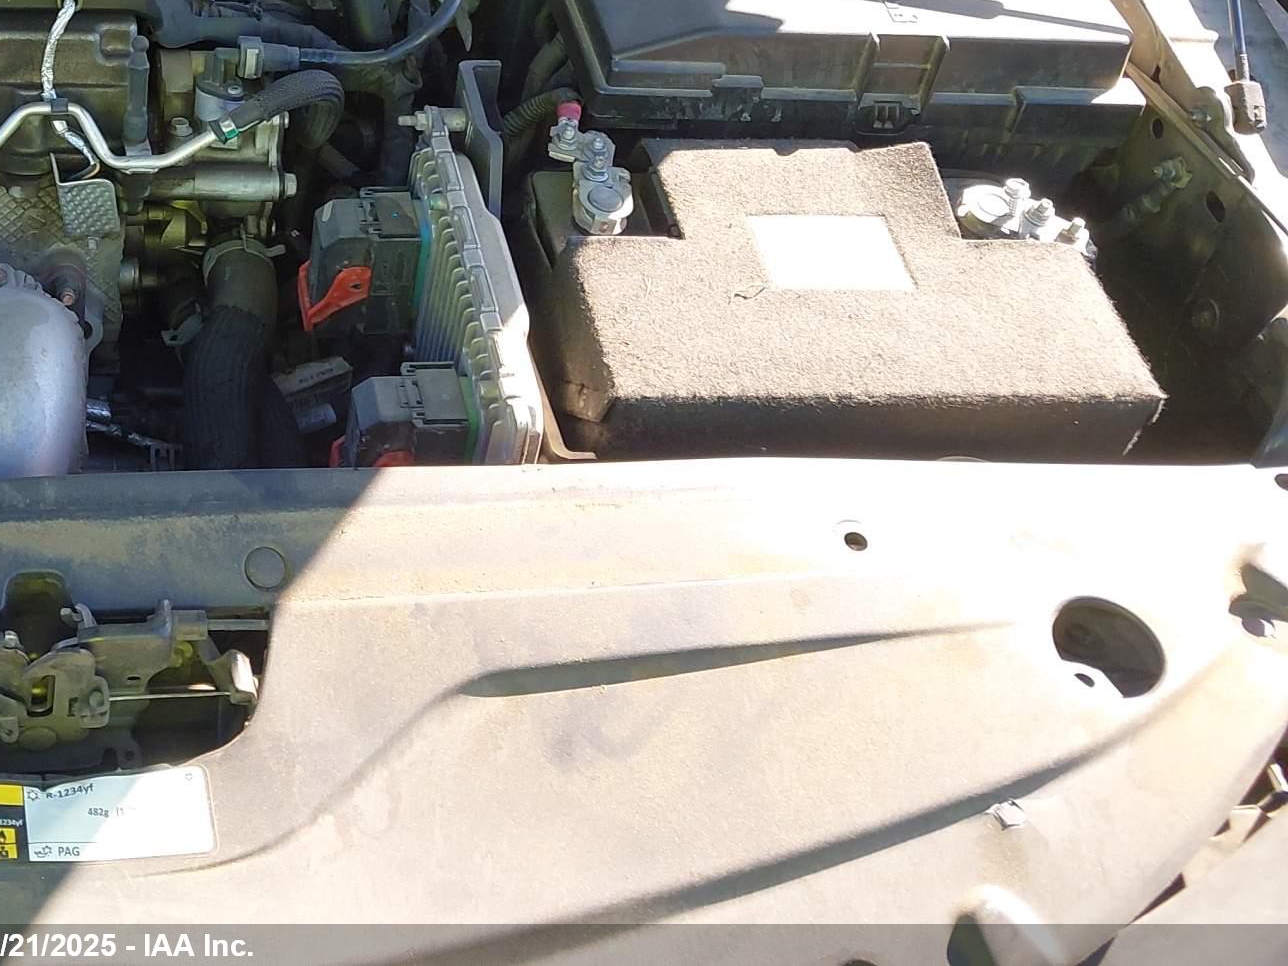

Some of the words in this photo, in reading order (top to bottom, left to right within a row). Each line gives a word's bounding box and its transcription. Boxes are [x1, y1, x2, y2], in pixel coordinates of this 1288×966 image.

[45, 782, 94, 799] R-1234yf
[87, 807, 110, 818] 482g
[57, 846, 81, 857] PAG
